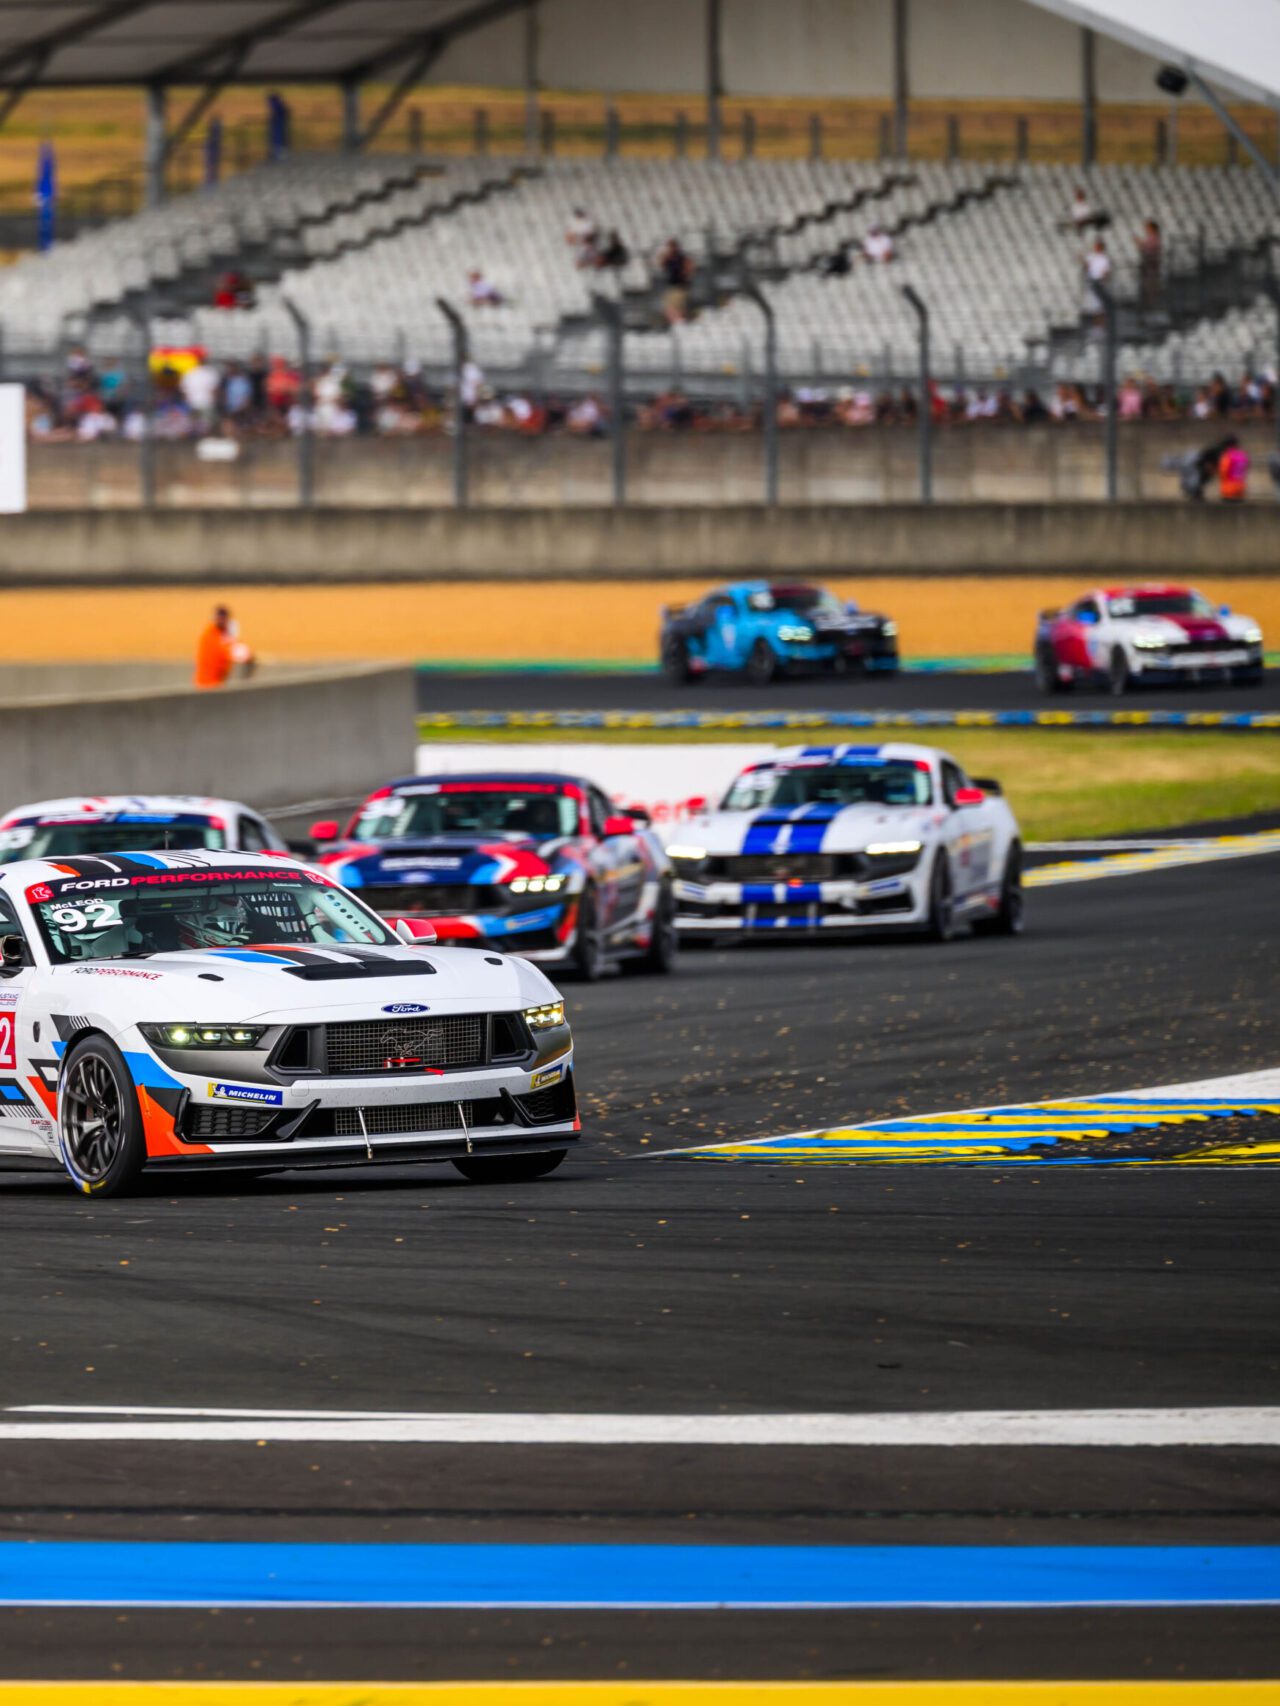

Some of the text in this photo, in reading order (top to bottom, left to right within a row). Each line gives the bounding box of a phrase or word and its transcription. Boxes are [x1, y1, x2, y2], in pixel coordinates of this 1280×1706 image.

[50, 898, 104, 910] McLEOD
[52, 904, 123, 932] 92
[228, 1090, 276, 1101] MICHELIN
